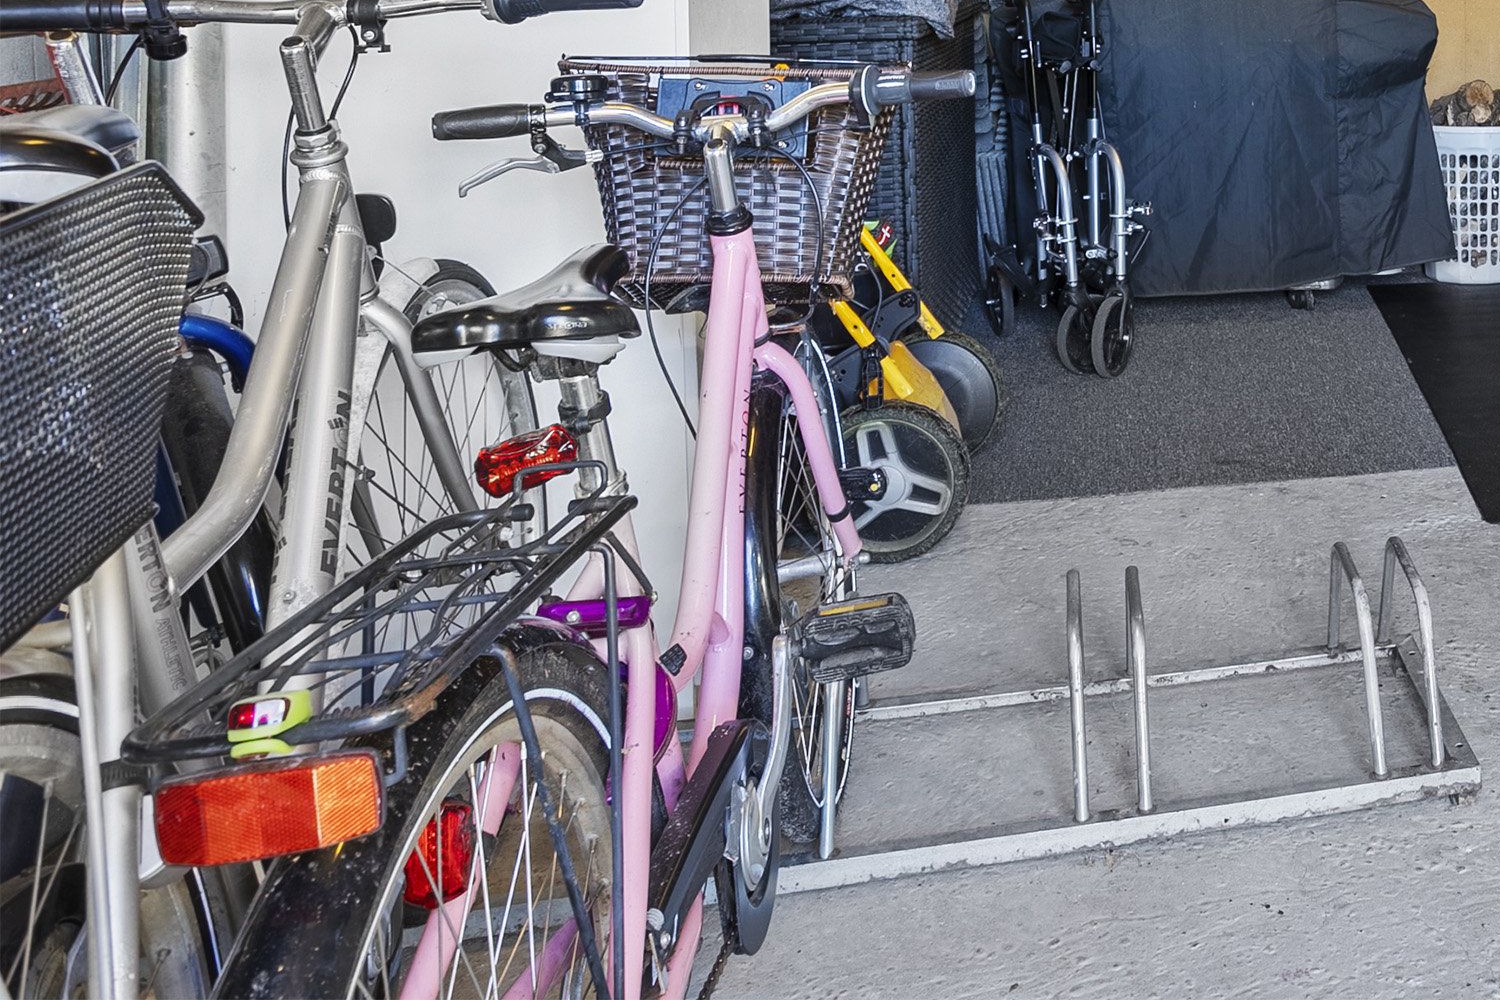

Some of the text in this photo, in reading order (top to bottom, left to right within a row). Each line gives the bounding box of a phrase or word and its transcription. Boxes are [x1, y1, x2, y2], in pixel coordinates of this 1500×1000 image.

[320, 390, 352, 577] EVERTON
[134, 525, 187, 690] ERTON ATHLETIC
